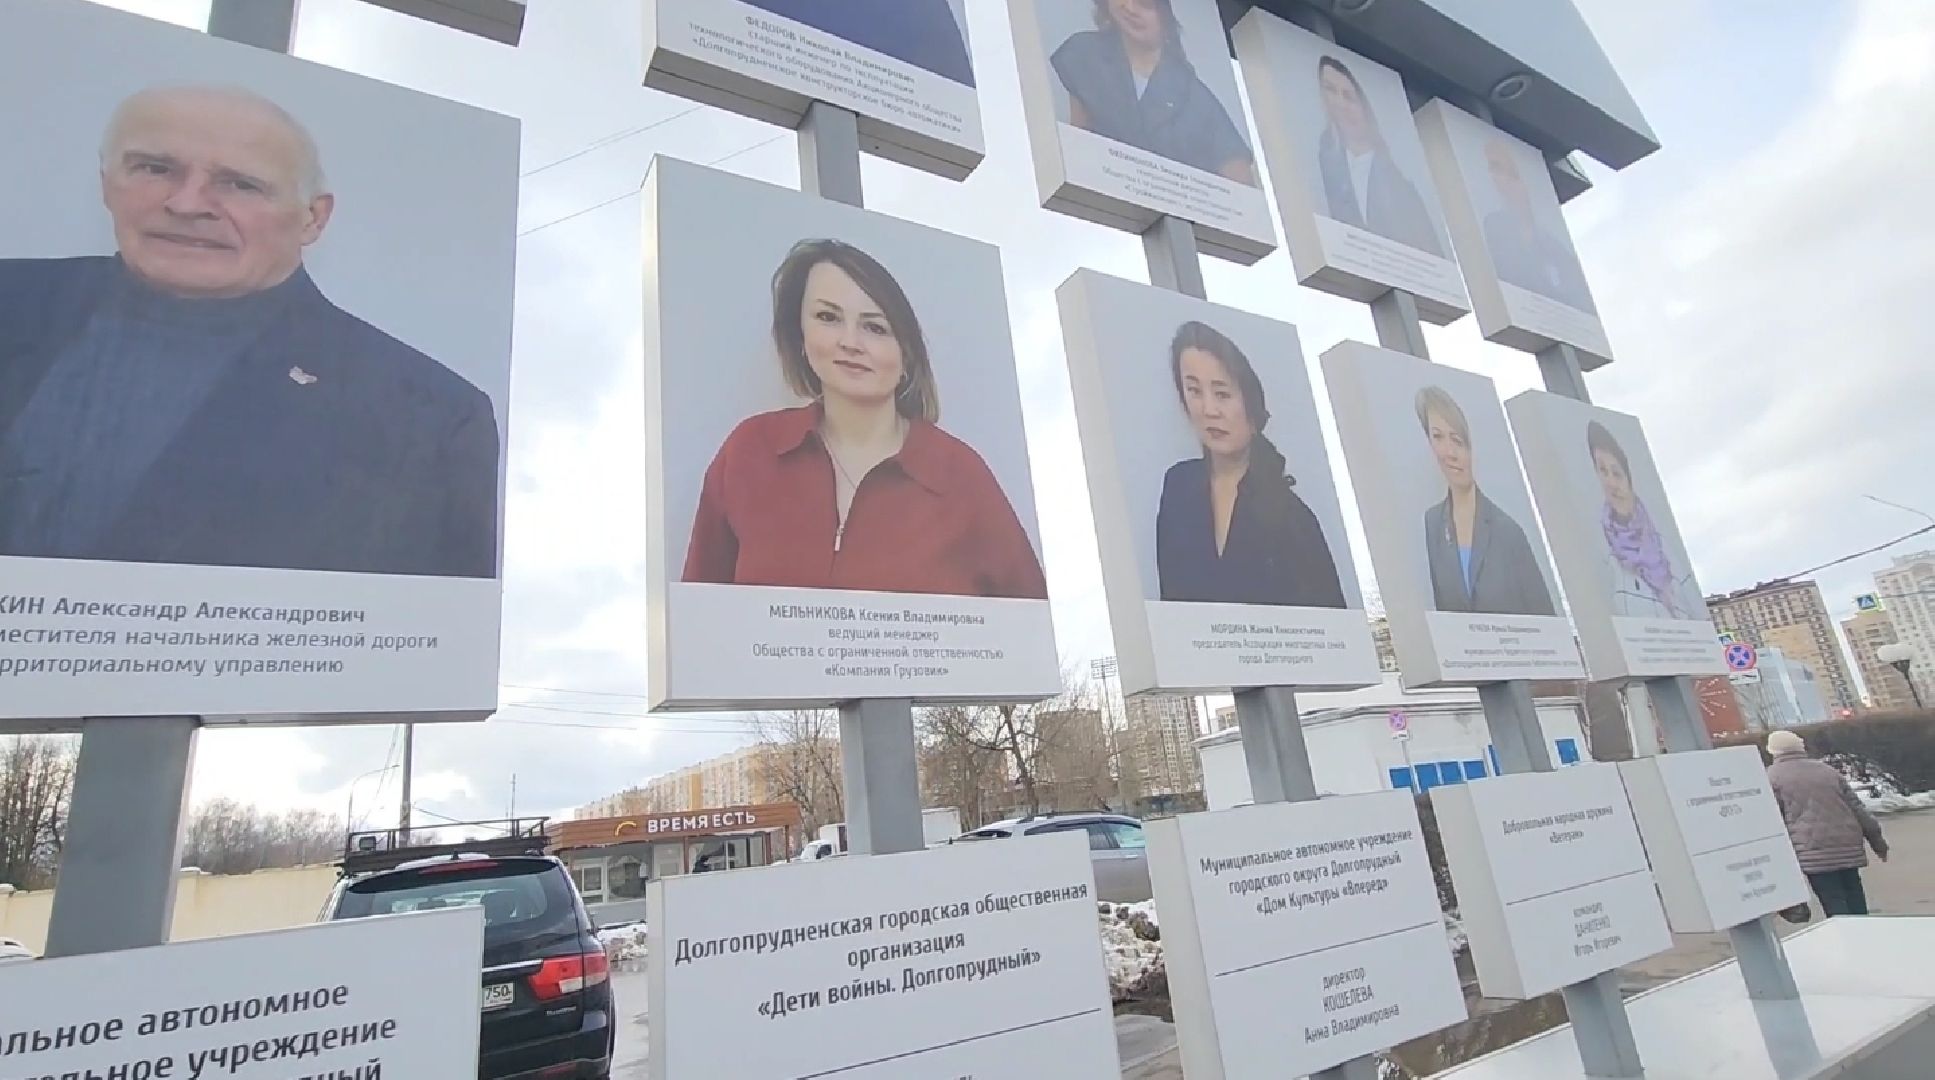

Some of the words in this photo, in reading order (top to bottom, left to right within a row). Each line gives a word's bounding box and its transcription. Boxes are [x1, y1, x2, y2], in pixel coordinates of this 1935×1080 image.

[53, 598, 187, 622] Александр
[196, 602, 365, 625] Александрович
[769, 605, 856, 621] МЕЛЬНИКОВА
[859, 606, 900, 622] Ксения
[903, 606, 984, 625] Владимировна
[126, 629, 259, 646] начальника
[266, 630, 365, 648] железной
[371, 634, 438, 650] дороги
[829, 627, 880, 641] ведущий
[883, 629, 939, 642] менеджер
[752, 643, 814, 659] Общества
[818, 646, 824, 657] с
[828, 643, 909, 660] ограниченной
[912, 646, 1003, 660] ответственностью
[214, 658, 344, 676] управлению
[824, 664, 890, 678] «Компания
[894, 664, 949, 679] Грузовик»
[648, 815, 708, 833] ВРЕМЯ
[713, 811, 756, 828] ЕСТЬ
[1200, 848, 1293, 876] Муниципальное
[1296, 838, 1355, 859] автономное
[1357, 829, 1413, 852] учреждение
[1229, 872, 1291, 895] городского
[1293, 865, 1329, 884] округа
[1331, 851, 1402, 879] Долгопрудный
[1257, 895, 1286, 915] «Дом
[1289, 887, 1339, 910] Культуры
[675, 915, 873, 966] Долгопрудненская
[879, 900, 970, 933] городская
[975, 883, 1088, 914] общественная
[847, 931, 965, 970] организация
[758, 988, 821, 1019] «Дети
[828, 976, 896, 1005] войны.
[902, 950, 1041, 993] Долгопрудный»
[1323, 967, 1366, 990] директор
[1323, 985, 1374, 1013] КОШЕЛЕВА
[0, 1020, 123, 1055] льное
[137, 984, 349, 1037] автономное
[1304, 1025, 1330, 1044] Анна
[1331, 1004, 1399, 1037] Владимировна
[188, 1017, 396, 1079] учреждение
